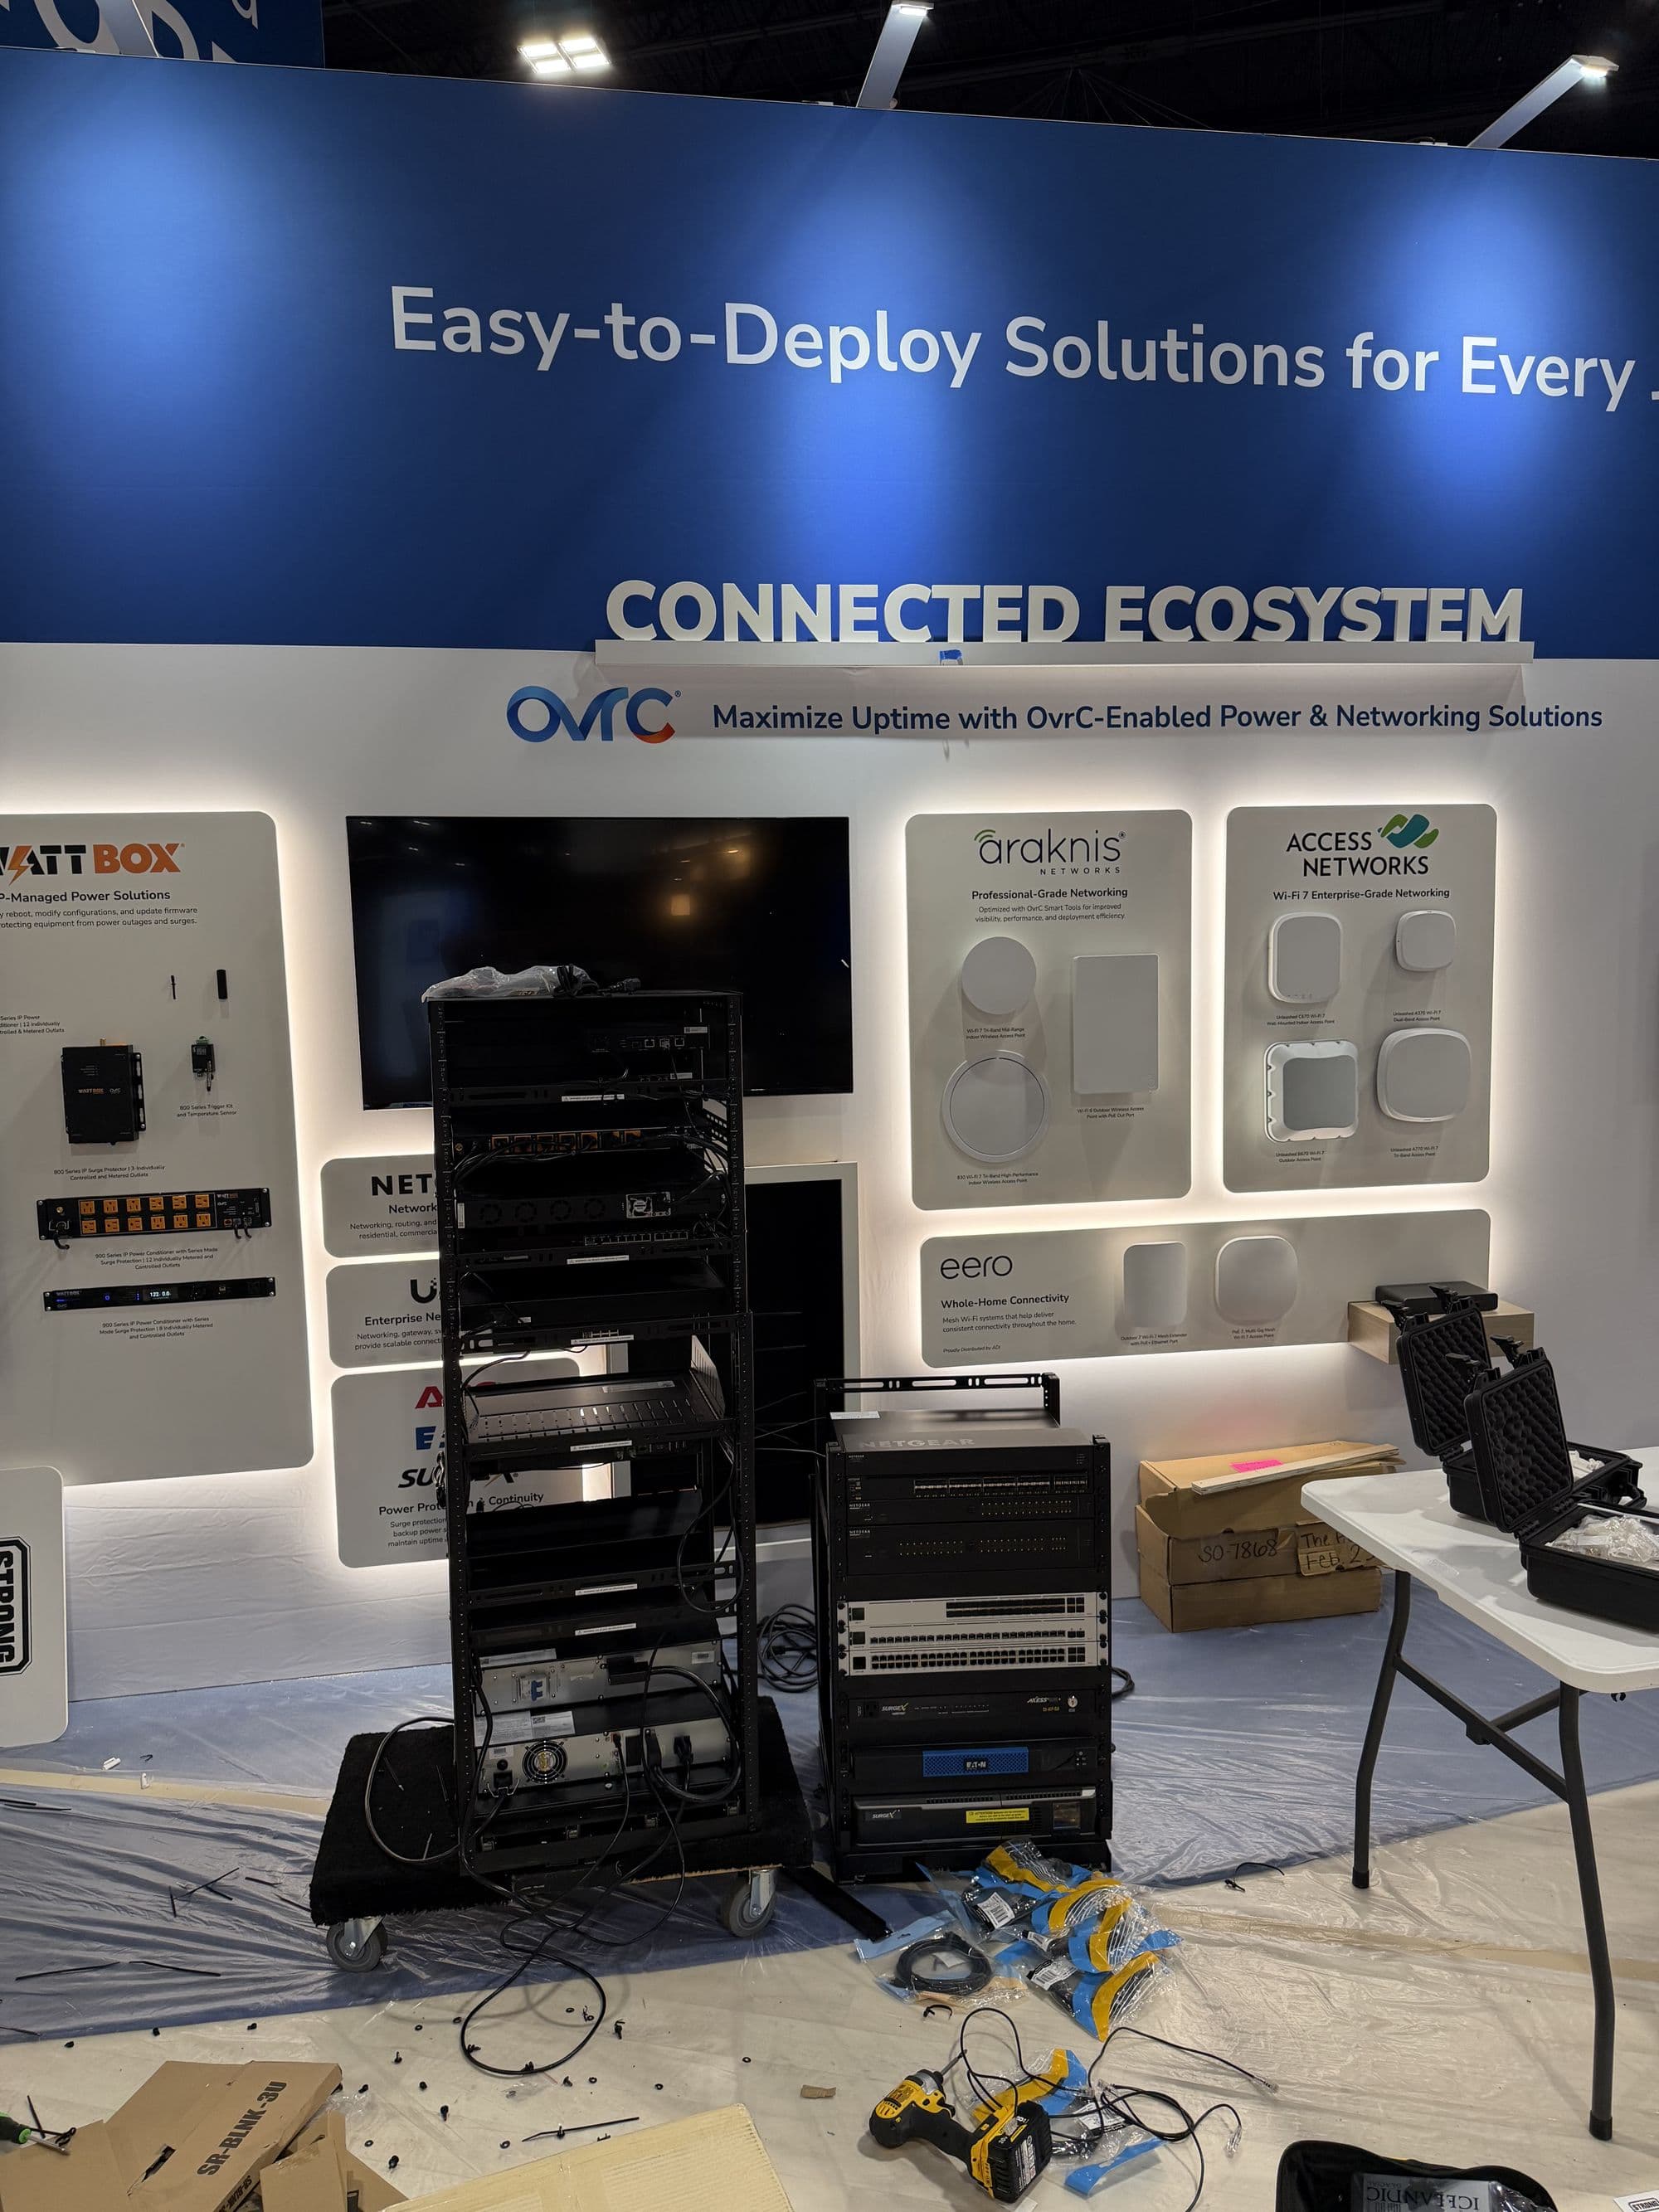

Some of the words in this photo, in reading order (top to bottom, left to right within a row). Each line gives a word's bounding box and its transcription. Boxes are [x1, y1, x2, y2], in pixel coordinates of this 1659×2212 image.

[391, 284, 982, 388] Easy-to-Deploy
[1004, 315, 1326, 388] Solutions
[1345, 331, 1439, 392] for
[1461, 335, 1636, 412] Every
[606, 580, 1080, 643] CONNECTED
[1105, 585, 1523, 643] ECOSYSTEM
[713, 705, 844, 730] Maximize
[852, 707, 948, 736] Uptime
[958, 707, 1018, 729] with
[1026, 705, 1212, 730] OvrC-Enabled
[1221, 705, 1301, 728] Power
[1310, 706, 1328, 727] &
[1336, 705, 1481, 733] Networking
[1488, 705, 1603, 728] Solutions
[980, 829, 1121, 864] araknis
[1287, 832, 1372, 852] ACCESS
[1040, 867, 1120, 875] NETWORKS
[1303, 855, 1428, 877] NETWORKS
[71, 891, 110, 902] Power
[114, 890, 171, 901] Solutions
[971, 889, 1068, 900] Professional-Grade
[1070, 887, 1128, 898] Networking
[1273, 891, 1300, 900] Wi-Fi
[1302, 891, 1309, 899] 7
[1311, 889, 1394, 901] Enterprise-Grade
[1395, 887, 1450, 898] Networking
[35, 909, 61, 917] modify
[63, 908, 119, 916] configurations,
[136, 907, 163, 916] update
[1092, 903, 1121, 912] improved
[34, 921, 75, 929] equipment
[96, 920, 119, 928] power
[122, 918, 153, 927] outages
[170, 917, 197, 926] surges.
[975, 915, 1002, 923] visibility,
[1058, 913, 1094, 921] deployment
[350, 1221, 394, 1230] Networking,
[395, 1220, 422, 1228] routing,
[359, 1230, 398, 1239] residential,
[400, 1228, 437, 1237] commercia
[940, 1255, 1013, 1280] eero
[941, 1297, 1007, 1309] Whole-Home
[1010, 1293, 1070, 1305] Connectivity
[365, 1314, 422, 1326] Enterprise
[980, 1314, 1005, 1322] systems
[1019, 1312, 1033, 1320] help
[975, 1323, 1011, 1332] connectivity
[1012, 1320, 1046, 1330] throughout
[357, 1331, 400, 1339] Networking,
[401, 1329, 433, 1338] gateway,
[354, 1340, 382, 1350] provide
[382, 1339, 412, 1348] scalable
[413, 1337, 441, 1345] connect
[860, 1438, 975, 1448] NETGEAR
[378, 1504, 415, 1515] Power
[489, 1493, 544, 1506] Continuity
[390, 1520, 411, 1529] Surge
[412, 1517, 447, 1527] protection
[393, 1529, 418, 1538] backup
[420, 1528, 441, 1536] power
[387, 1539, 418, 1547] maintain
[419, 1536, 444, 1545] uptime
[1301, 1533, 1330, 1548] The
[197, 2081, 287, 2176] SR-BLNK-3U
[1366, 2186, 1480, 2211] ICELANDIC
